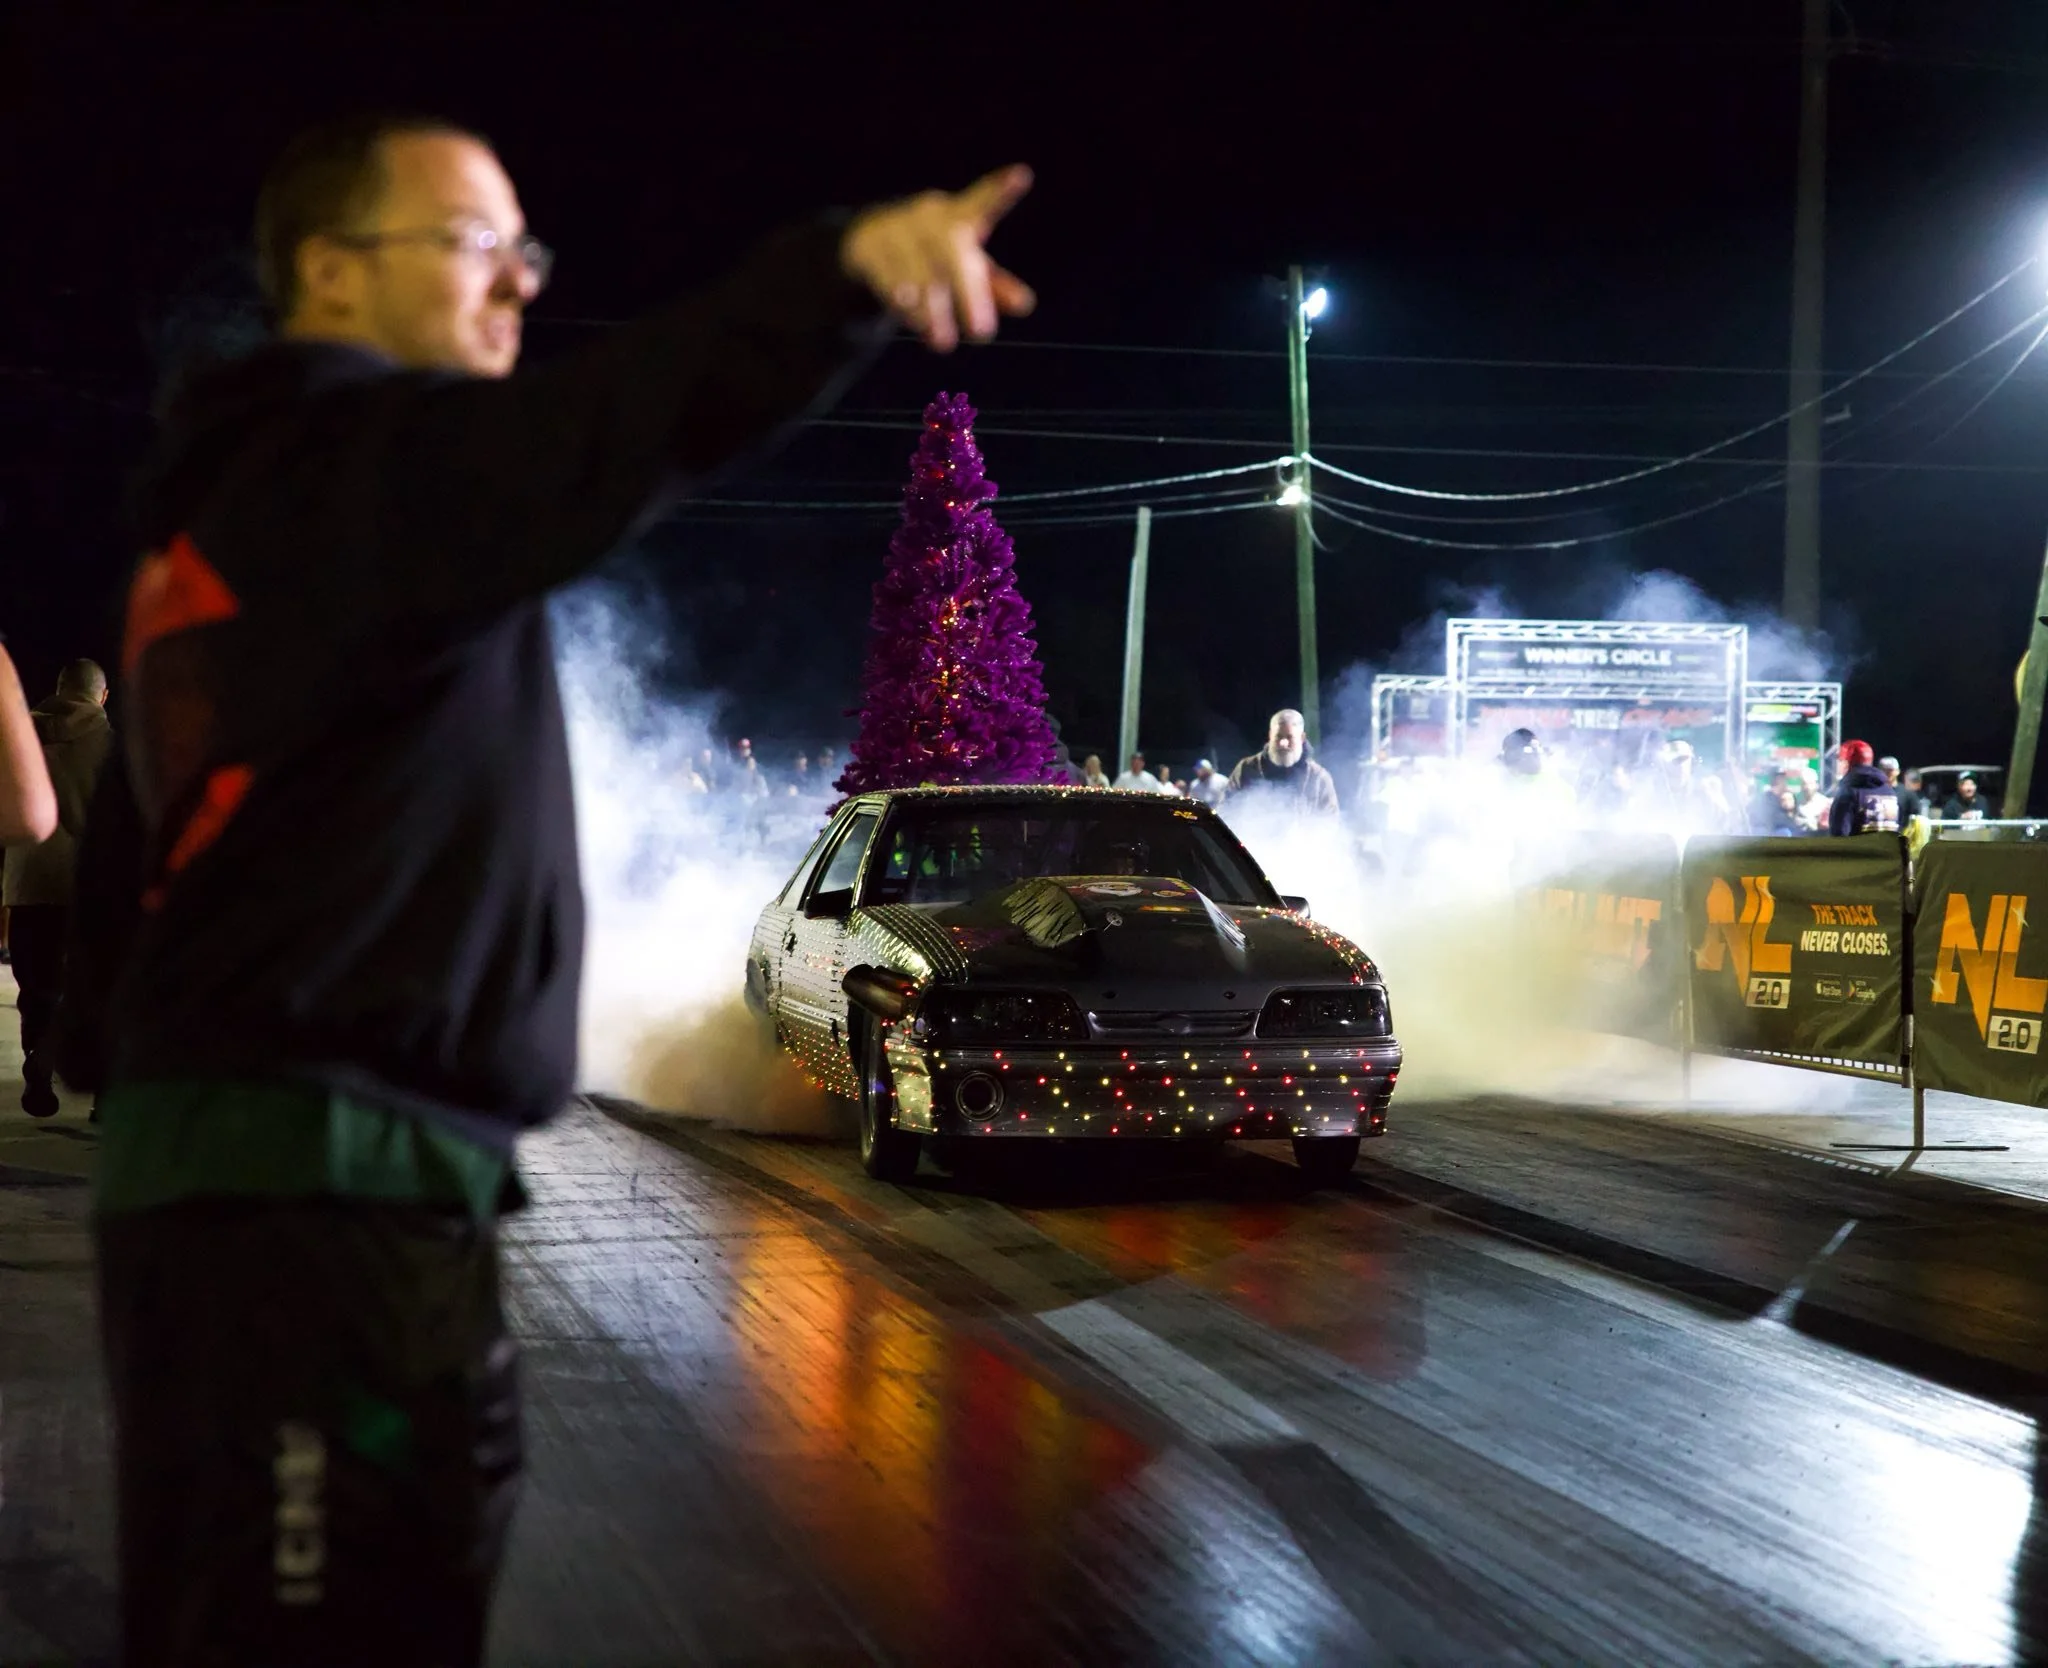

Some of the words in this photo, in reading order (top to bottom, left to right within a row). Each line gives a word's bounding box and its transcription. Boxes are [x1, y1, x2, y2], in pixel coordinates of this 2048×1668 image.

[1525, 647, 1608, 665] WINNER'S
[1611, 648, 1672, 666] CIRCLE
[1811, 904, 1837, 925] THE
[1834, 904, 1878, 926] TRACK
[1693, 875, 1793, 1000] NL
[1800, 930, 1839, 953] NEVER
[1841, 931, 1891, 956] CLOSES.
[1931, 893, 2048, 1041] NL
[1754, 980, 1782, 1006] 2.0
[1997, 1019, 2031, 1050] 2.0
